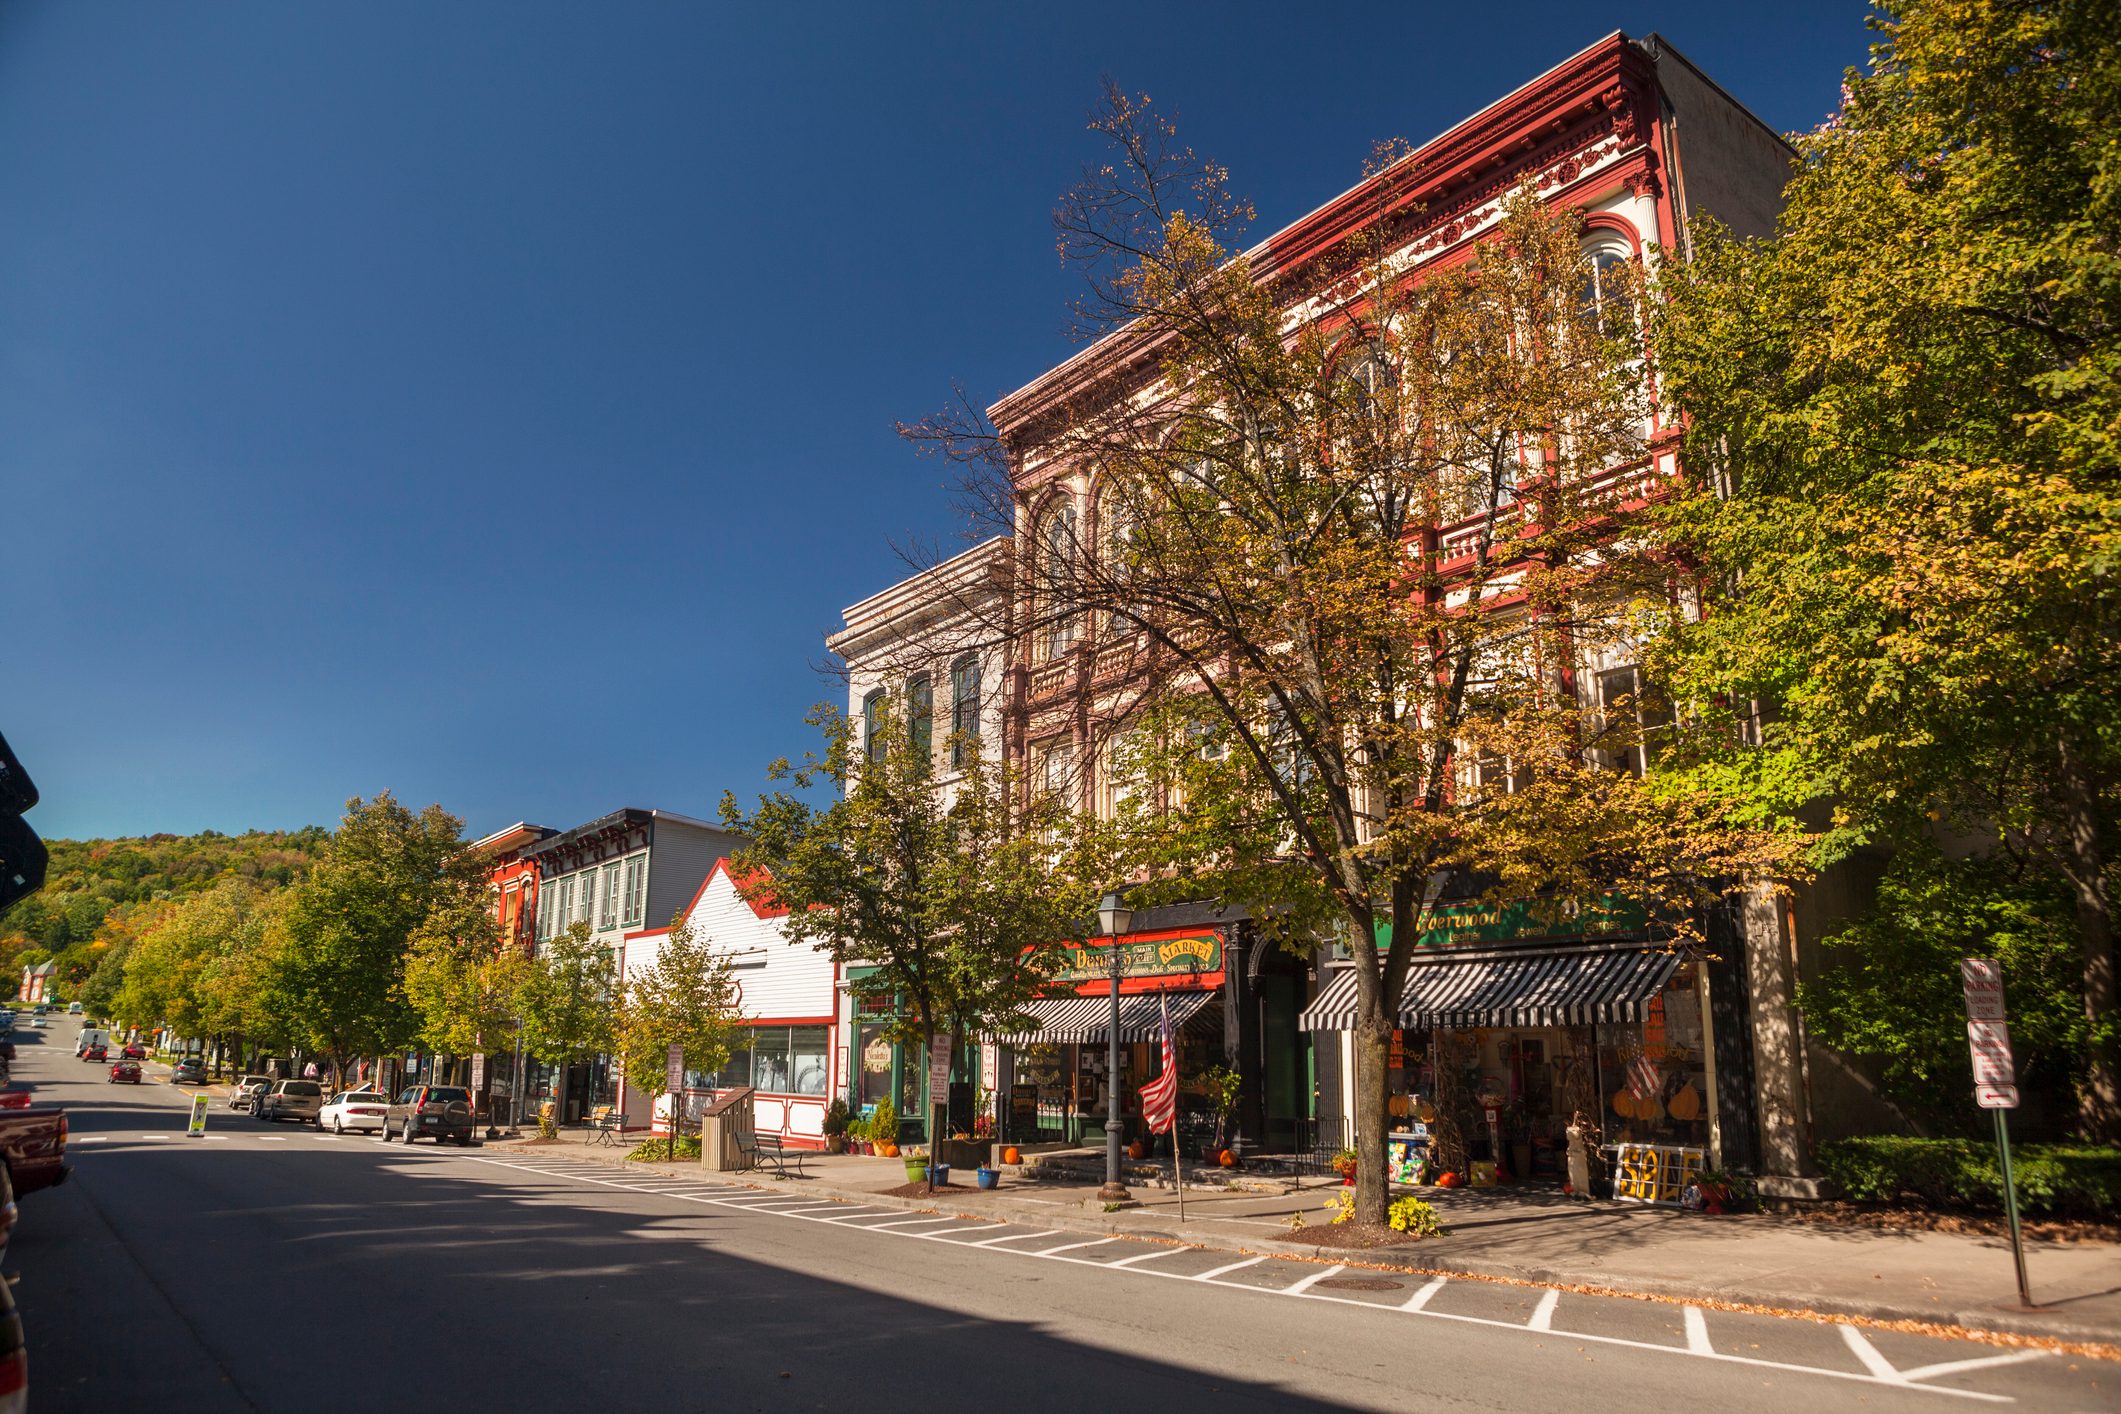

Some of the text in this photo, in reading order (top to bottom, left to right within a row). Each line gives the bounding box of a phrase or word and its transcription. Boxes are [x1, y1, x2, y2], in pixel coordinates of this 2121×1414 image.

[1416, 905, 1501, 932] Rverwood
[1450, 917, 1622, 942] Leather Jewelry Games
[1076, 949, 1131, 969] Dann's
[1162, 941, 1210, 962] MARKET
[1973, 964, 1987, 977] NO
[1965, 980, 2000, 992] PARKING
[1970, 996, 1998, 1005] LOADING
[1976, 1006, 1996, 1014] ZONE
[1620, 1147, 1702, 1201] SALE
